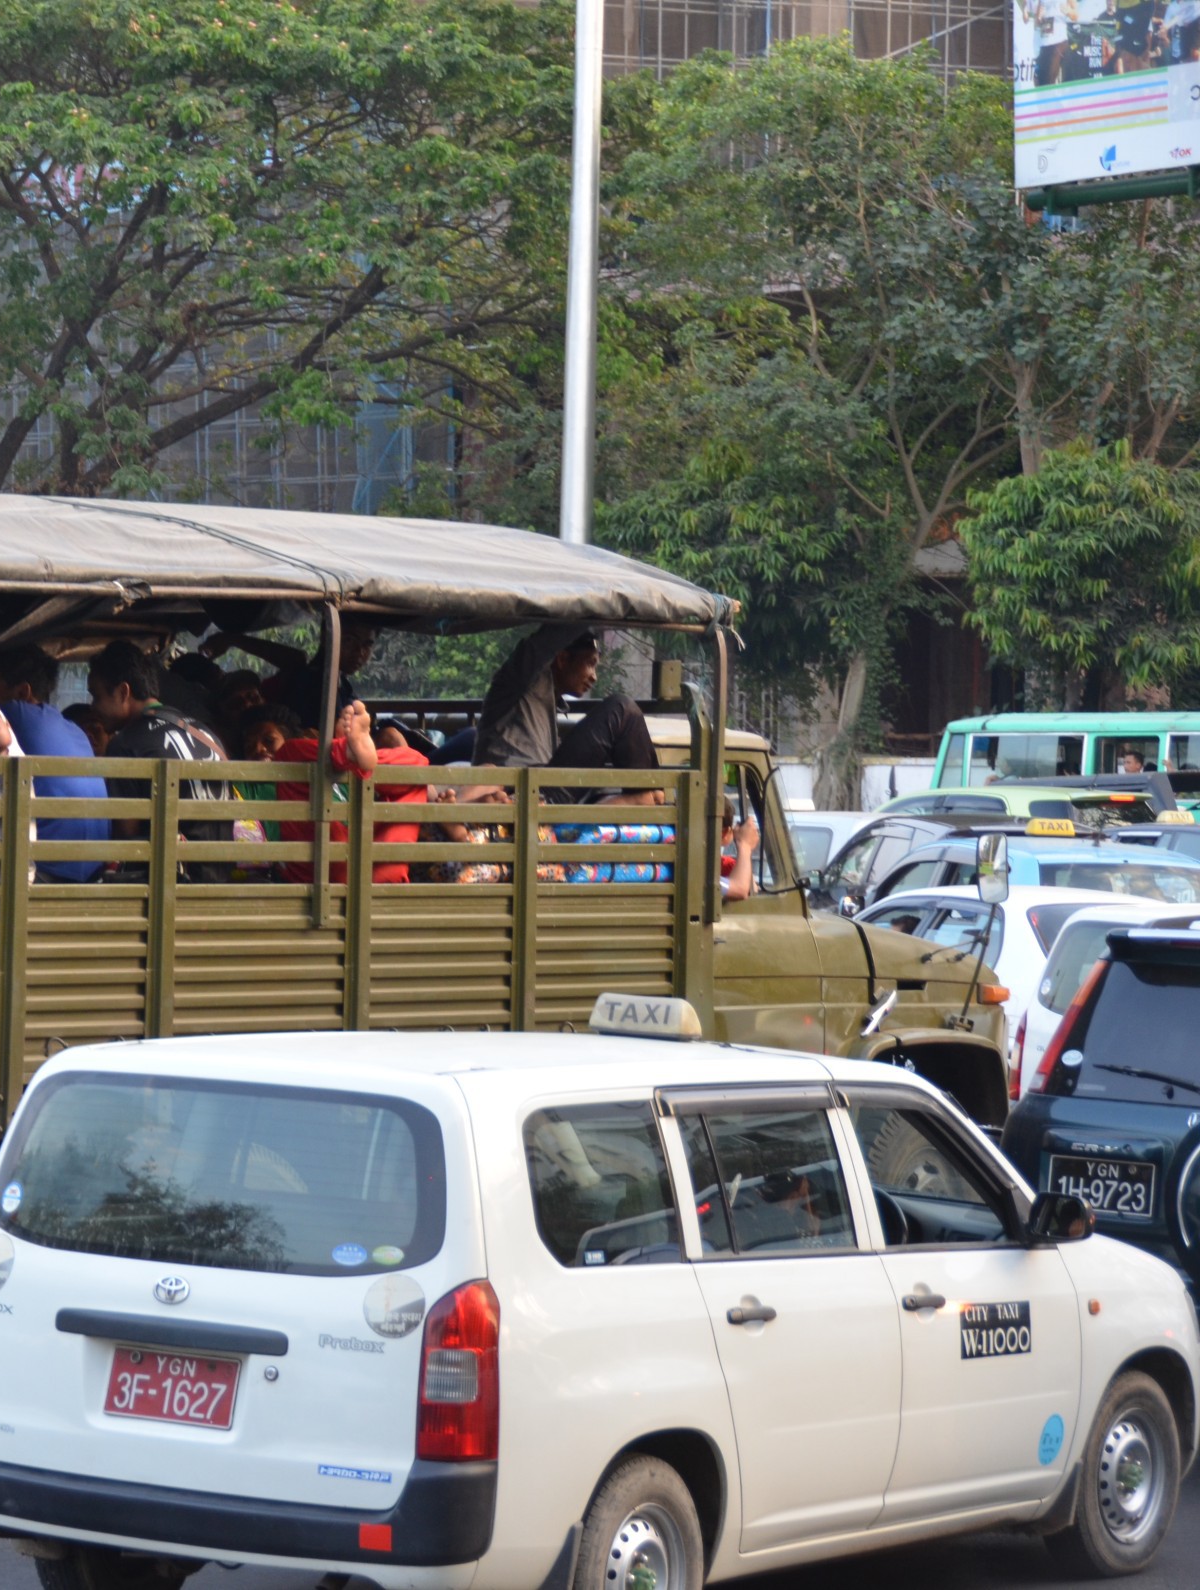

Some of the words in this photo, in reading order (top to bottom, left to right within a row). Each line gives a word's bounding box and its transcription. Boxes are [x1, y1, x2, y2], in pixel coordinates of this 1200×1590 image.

[1039, 821, 1069, 831] TAXI
[605, 1001, 671, 1024] TAXI
[1087, 1161, 1119, 1178] YGN
[1058, 1176, 1146, 1212] 1H-9723
[965, 1306, 988, 1322] CITY
[996, 1303, 1019, 1320] TAXI
[318, 1333, 385, 1354] Probox
[157, 1355, 196, 1378] YGN
[113, 1372, 227, 1420] 3F-1627
